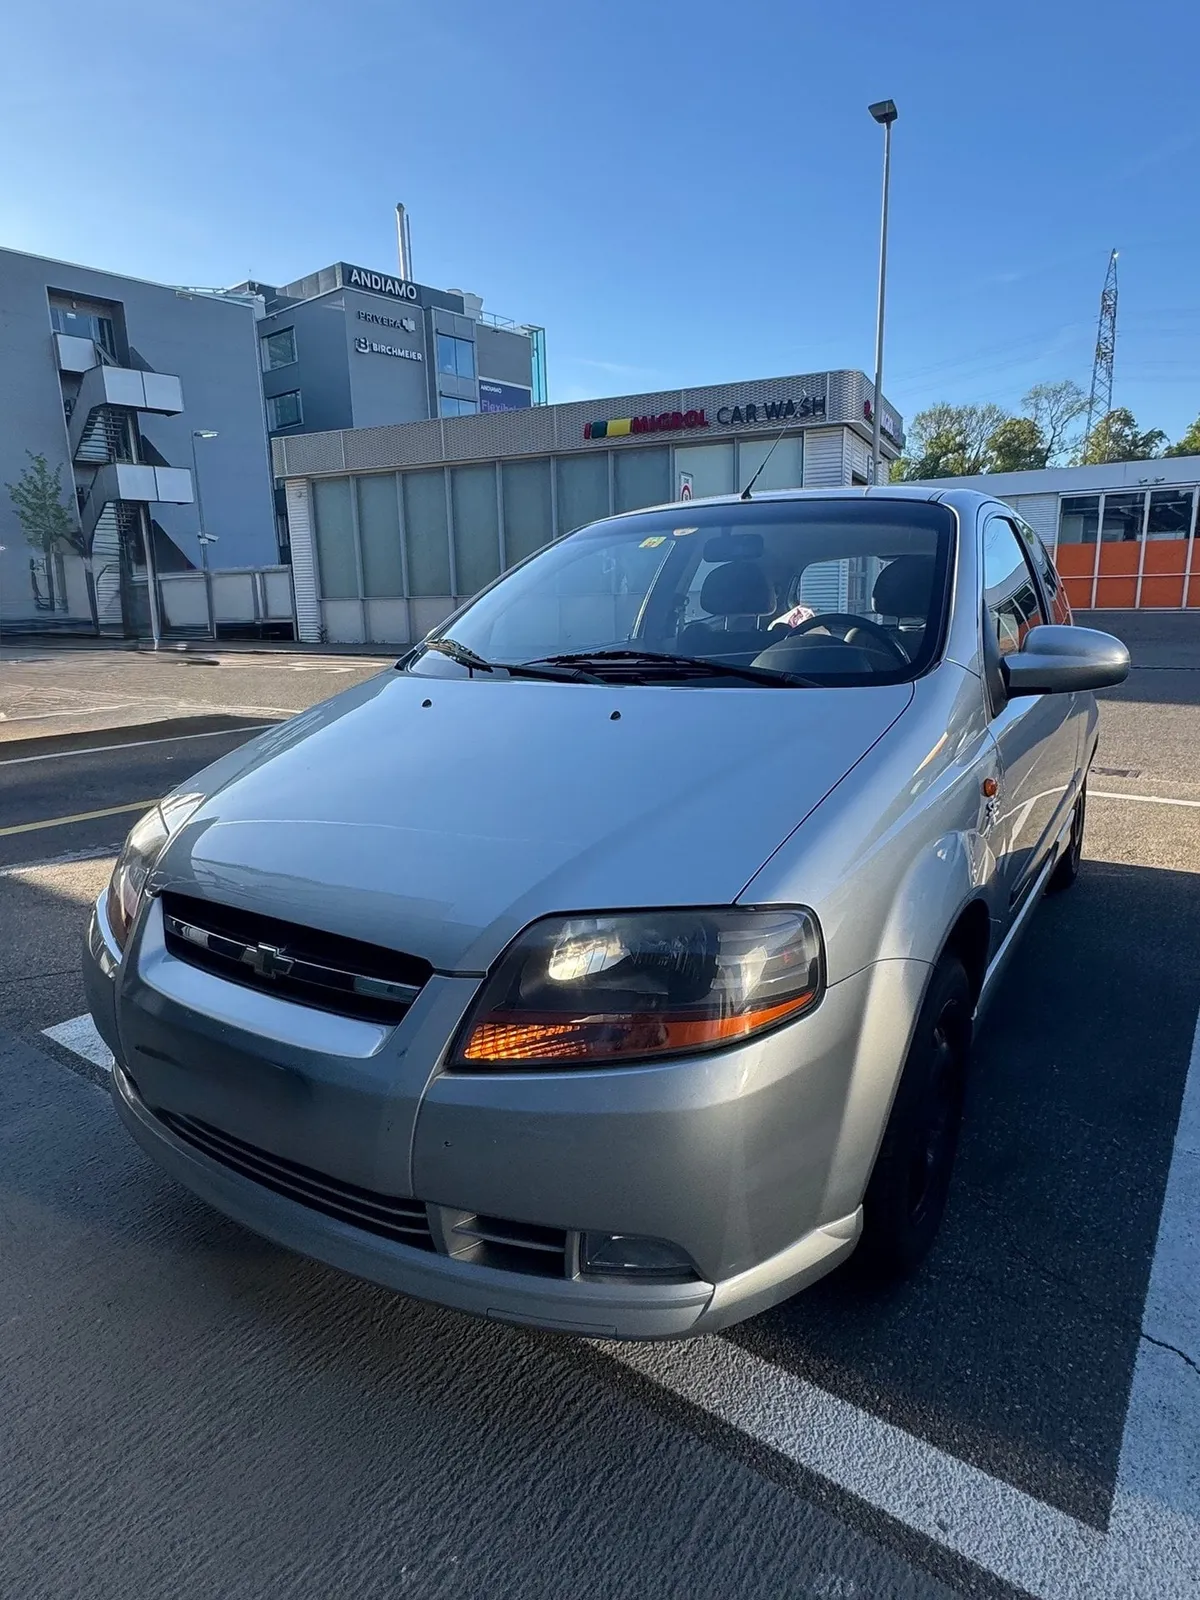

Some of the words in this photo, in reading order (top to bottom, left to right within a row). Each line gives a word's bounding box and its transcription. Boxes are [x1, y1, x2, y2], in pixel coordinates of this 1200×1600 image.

[351, 269, 417, 300] ANDIAMO
[358, 310, 402, 330] PRIVERA
[372, 342, 423, 362] BIRCHMEIER
[631, 409, 710, 434] MIGROL
[716, 403, 759, 425] CAR
[763, 395, 828, 419] WASH
